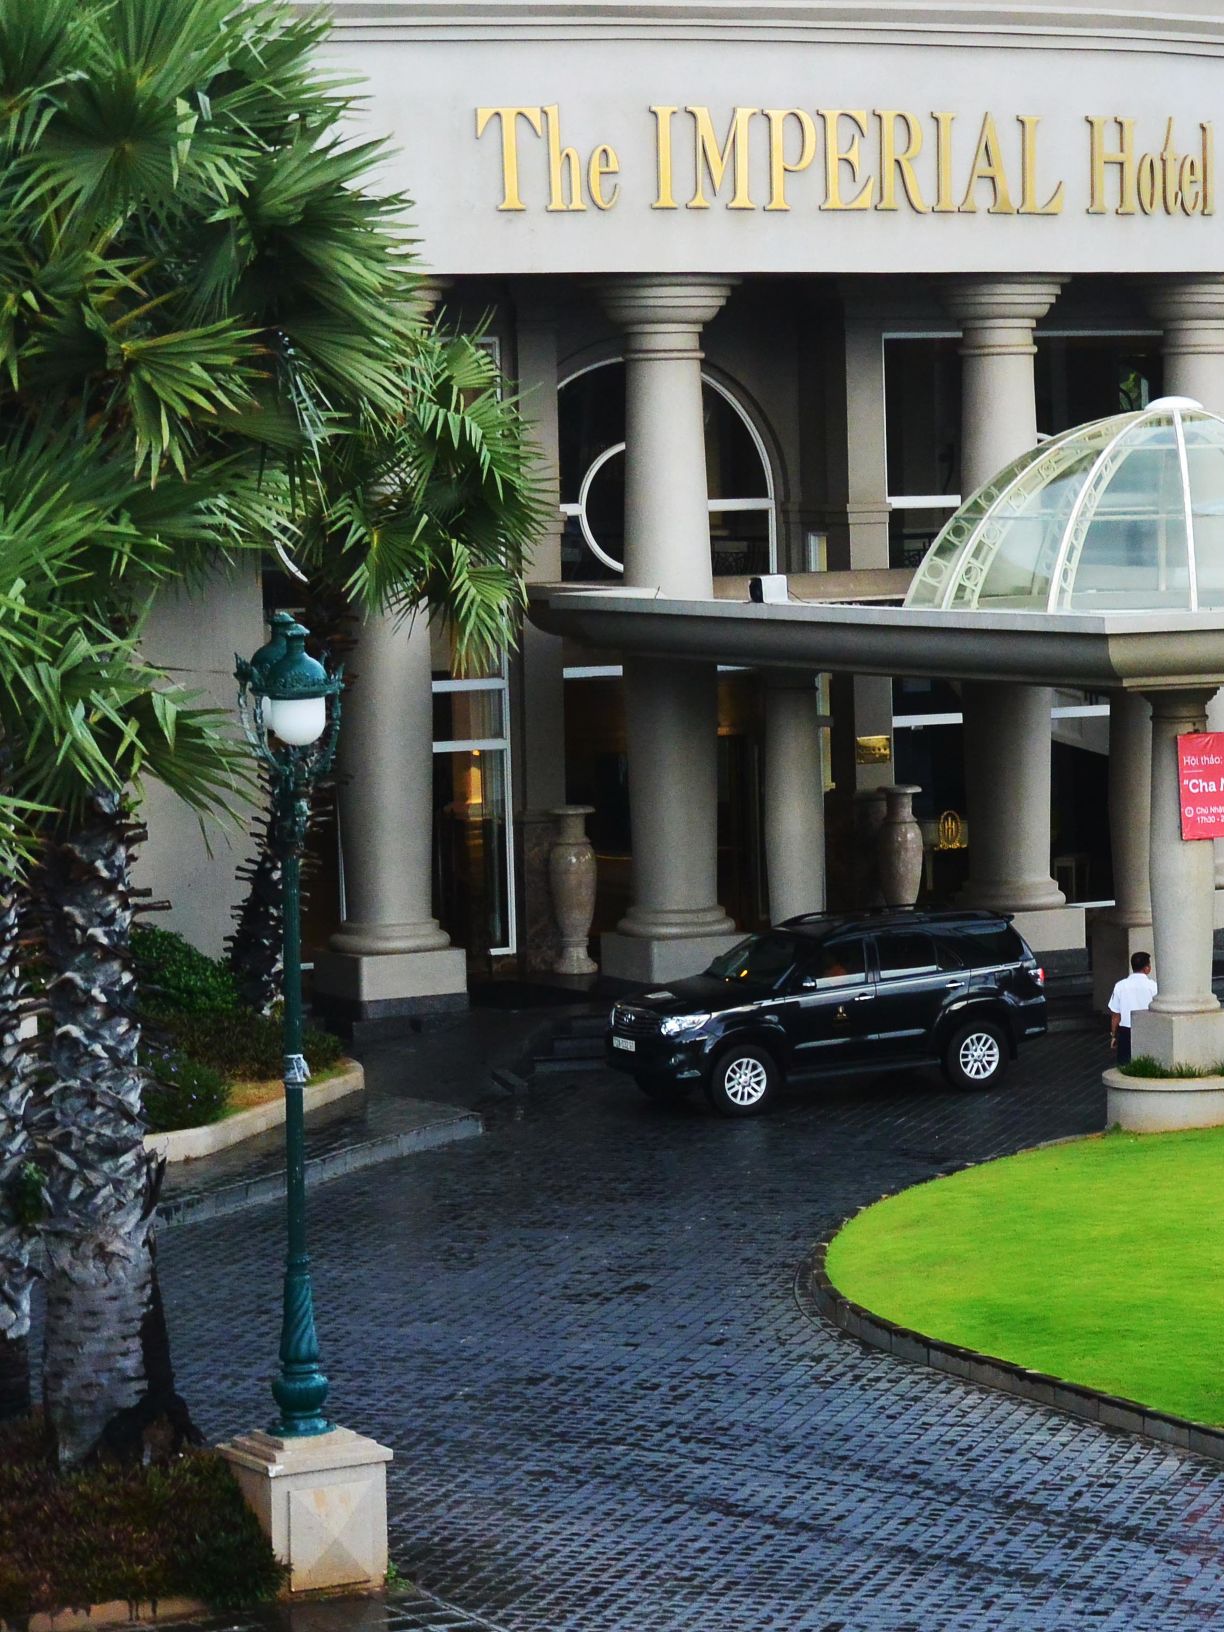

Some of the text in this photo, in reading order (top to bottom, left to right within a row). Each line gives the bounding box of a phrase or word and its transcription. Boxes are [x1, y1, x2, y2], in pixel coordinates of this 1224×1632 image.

[475, 104, 1216, 216] The IMPERIAL Hotel
[1183, 756, 1199, 767] Hội
